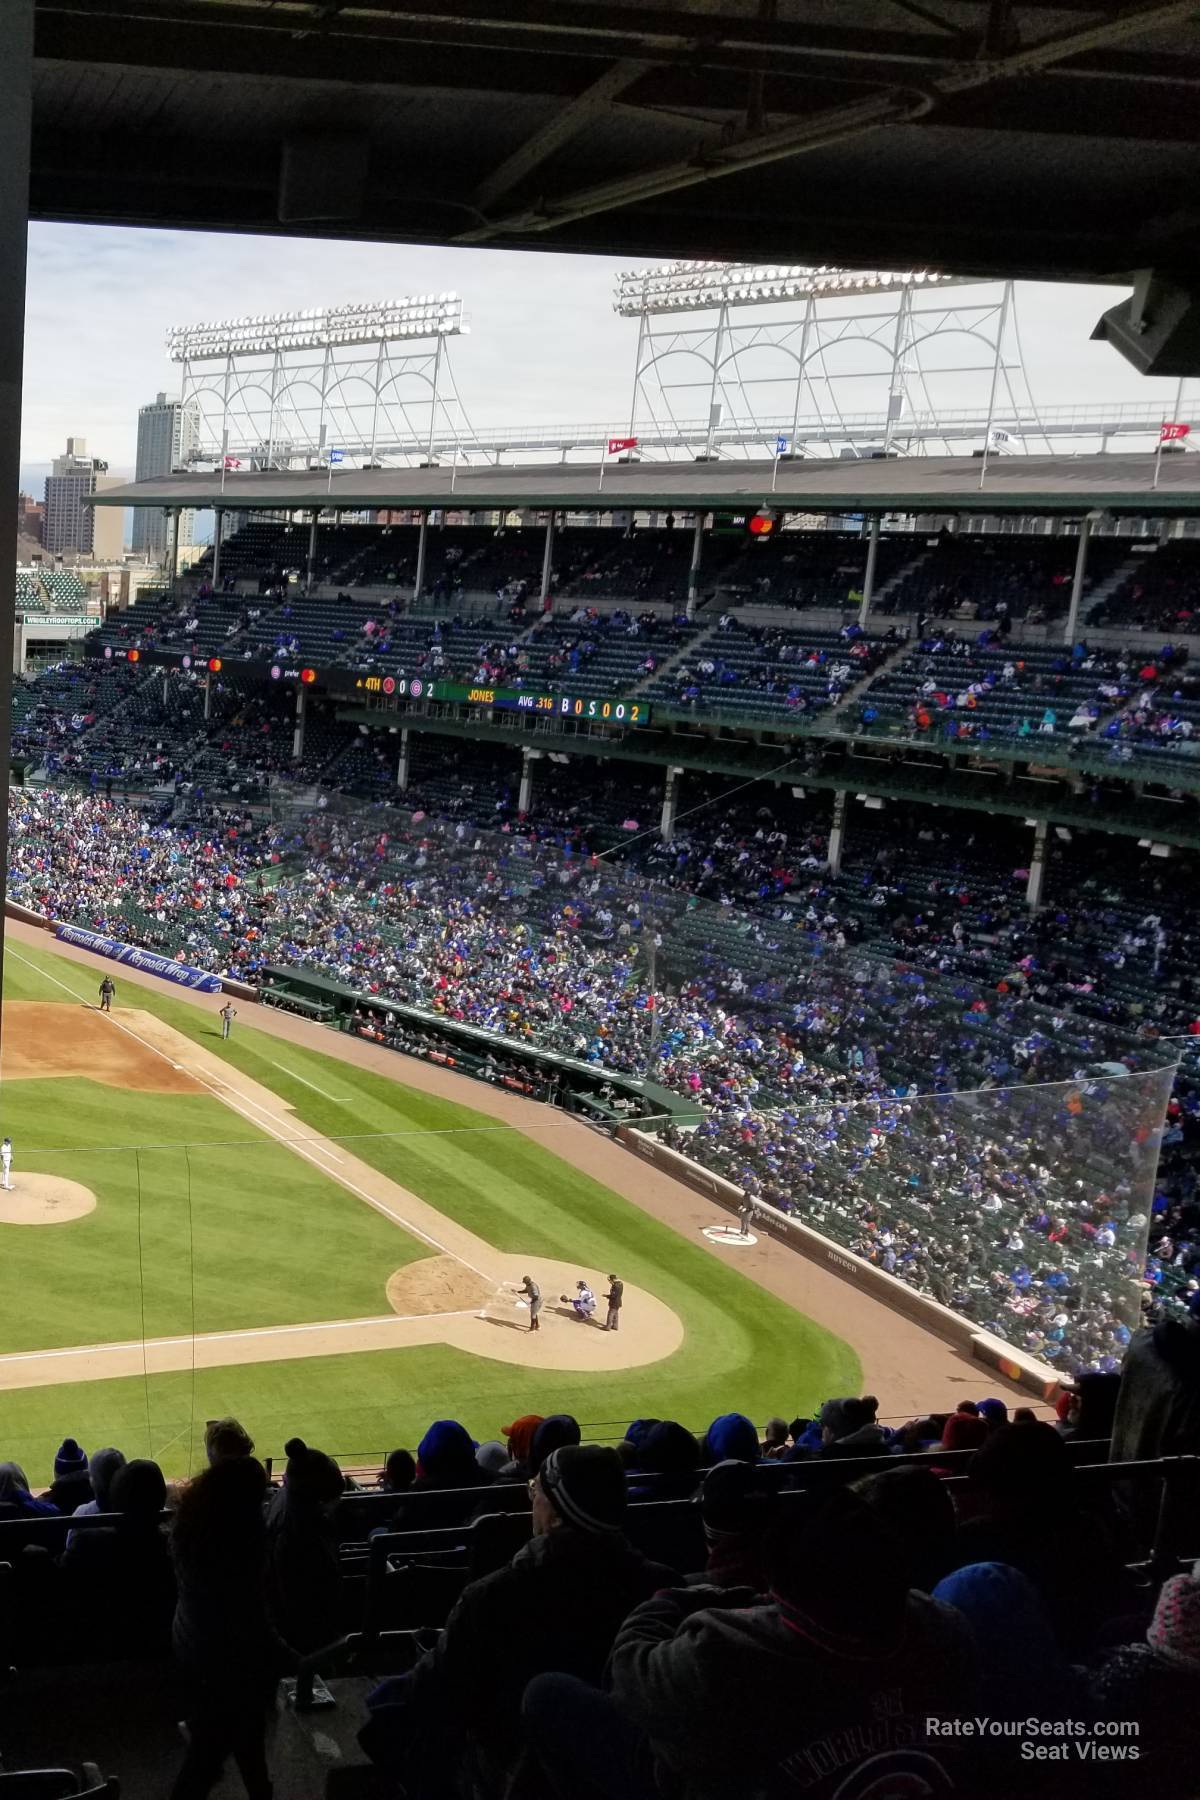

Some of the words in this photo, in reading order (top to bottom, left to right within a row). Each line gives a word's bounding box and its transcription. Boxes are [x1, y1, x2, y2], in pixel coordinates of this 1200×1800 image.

[194, 659, 207, 667] prefer
[284, 670, 299, 679] prefer
[365, 677, 380, 692] 4TH
[400, 680, 406, 694] 0
[427, 682, 433, 696] 2
[468, 688, 494, 702] JONES
[518, 695, 533, 707] AVG
[536, 697, 552, 709] .316
[562, 698, 568, 712] B
[575, 699, 582, 714] 0
[588, 700, 596, 715] S
[603, 702, 610, 717] 0
[632, 705, 638, 720] 2
[61, 928, 94, 947] Reynolds
[91, 938, 114, 954] Wrap
[129, 951, 165, 972] Reynolds
[163, 964, 189, 981] Wrap
[828, 1251, 857, 1272] nuveen
